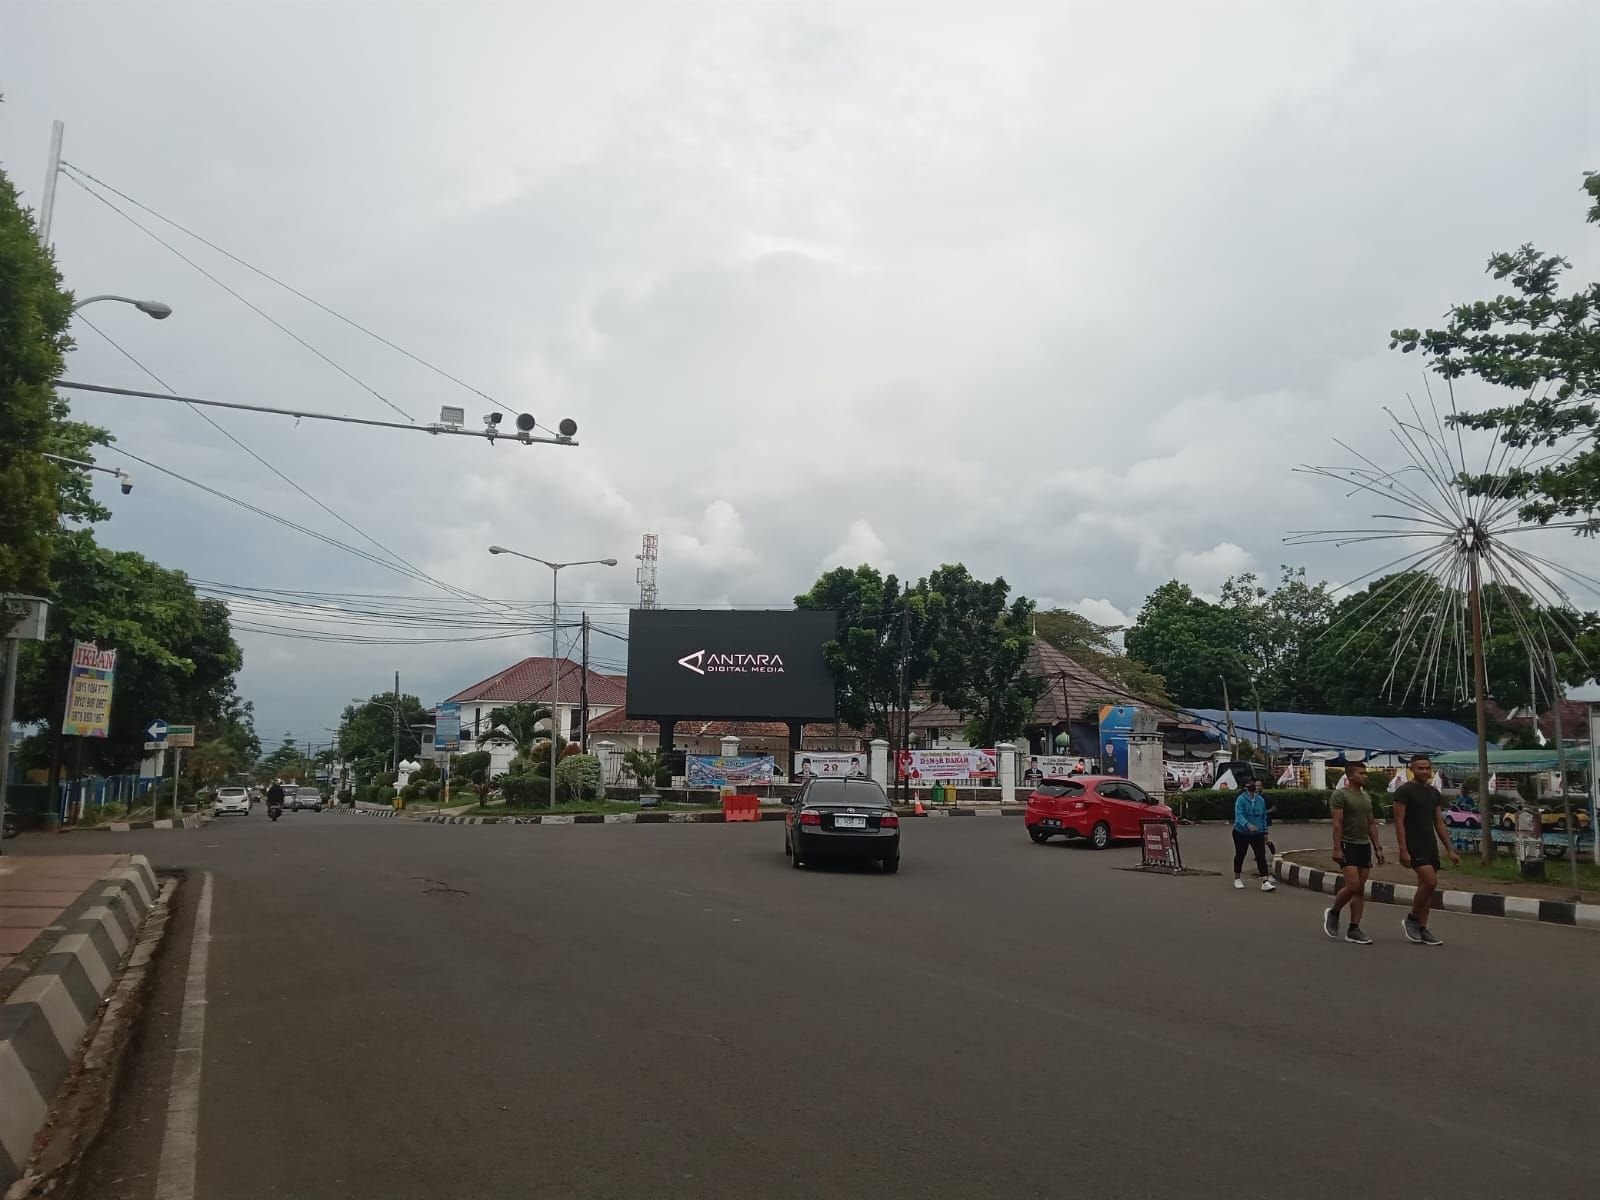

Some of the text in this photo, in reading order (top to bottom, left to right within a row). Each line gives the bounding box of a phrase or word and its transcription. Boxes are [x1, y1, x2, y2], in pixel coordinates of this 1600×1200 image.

[75, 648, 114, 669] IKLAN
[707, 654, 783, 665] ANTARA
[823, 763, 830, 771] 2
